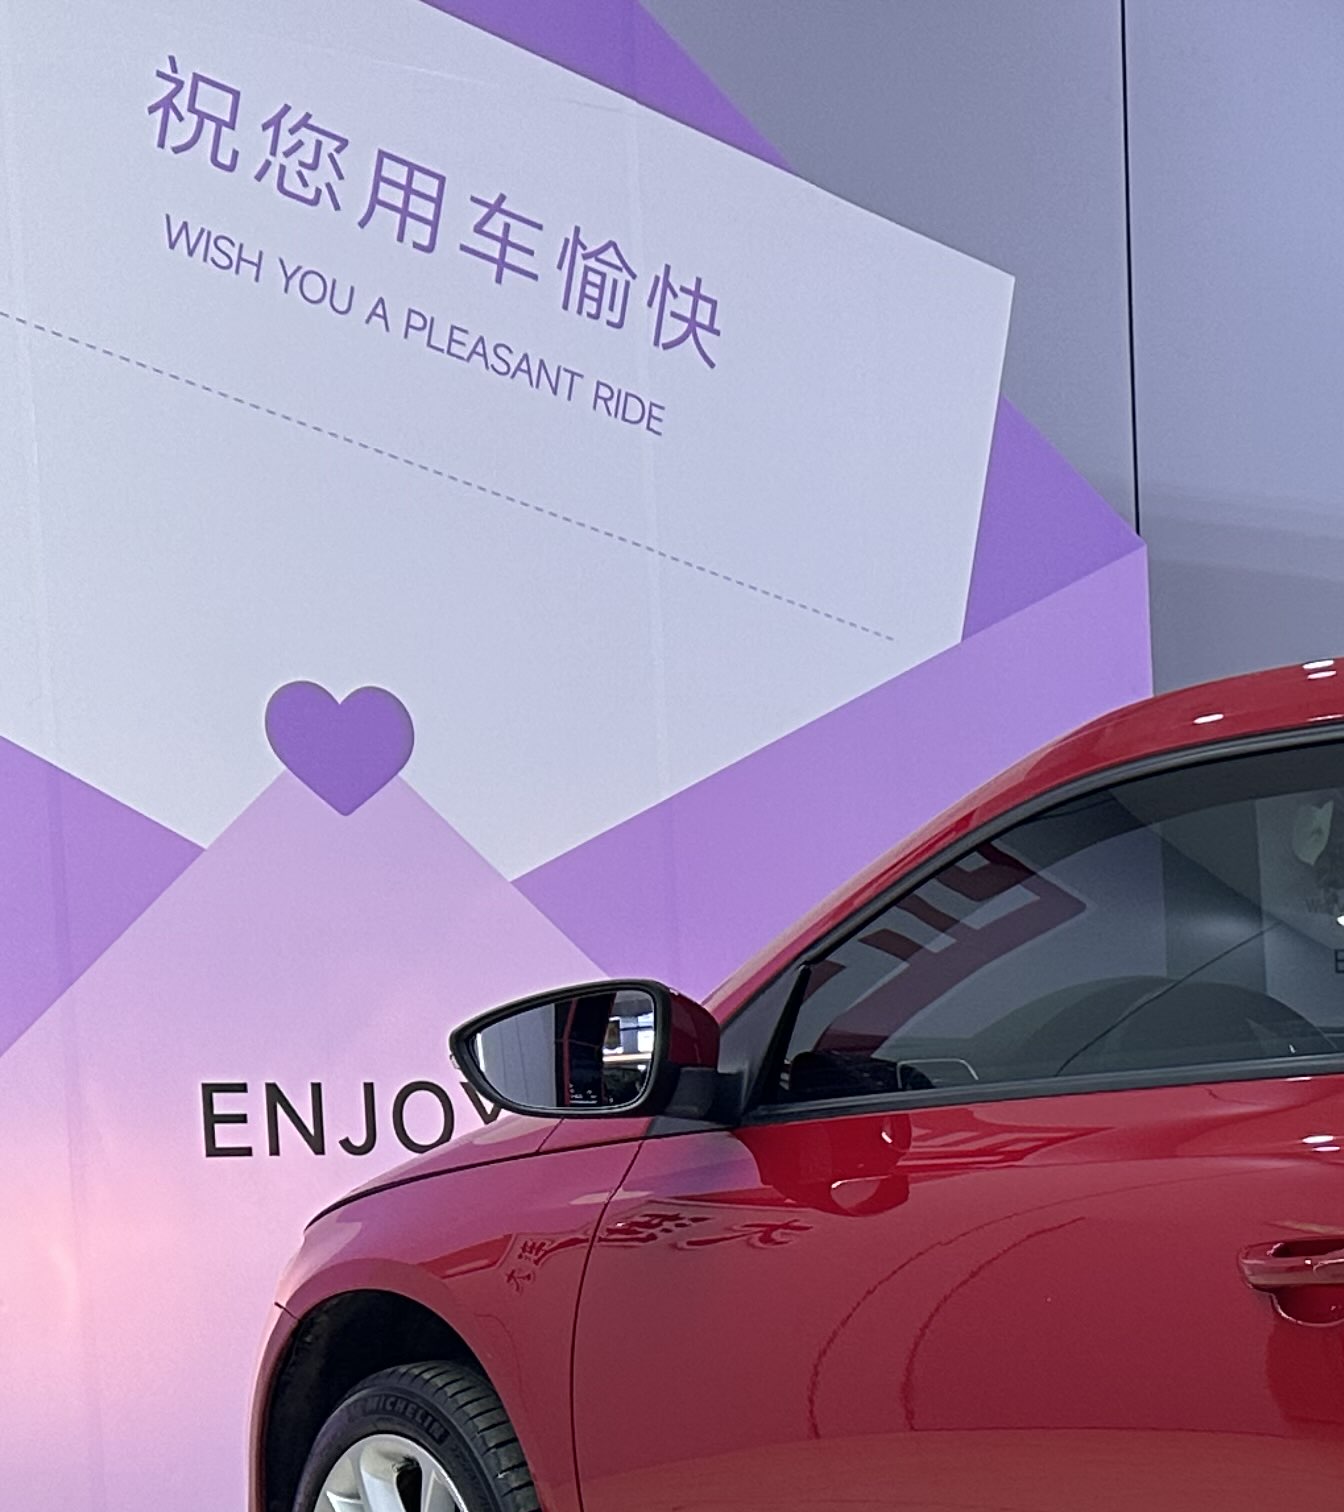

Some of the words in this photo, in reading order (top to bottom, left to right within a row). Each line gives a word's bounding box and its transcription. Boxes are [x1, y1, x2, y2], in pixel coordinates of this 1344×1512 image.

[148, 55, 722, 368] 祝您用车愉快
[164, 213, 264, 284] WISH
[278, 257, 355, 315] YOU
[364, 297, 390, 333] A
[404, 308, 585, 402] PLEASANT
[593, 380, 666, 436] RIDE
